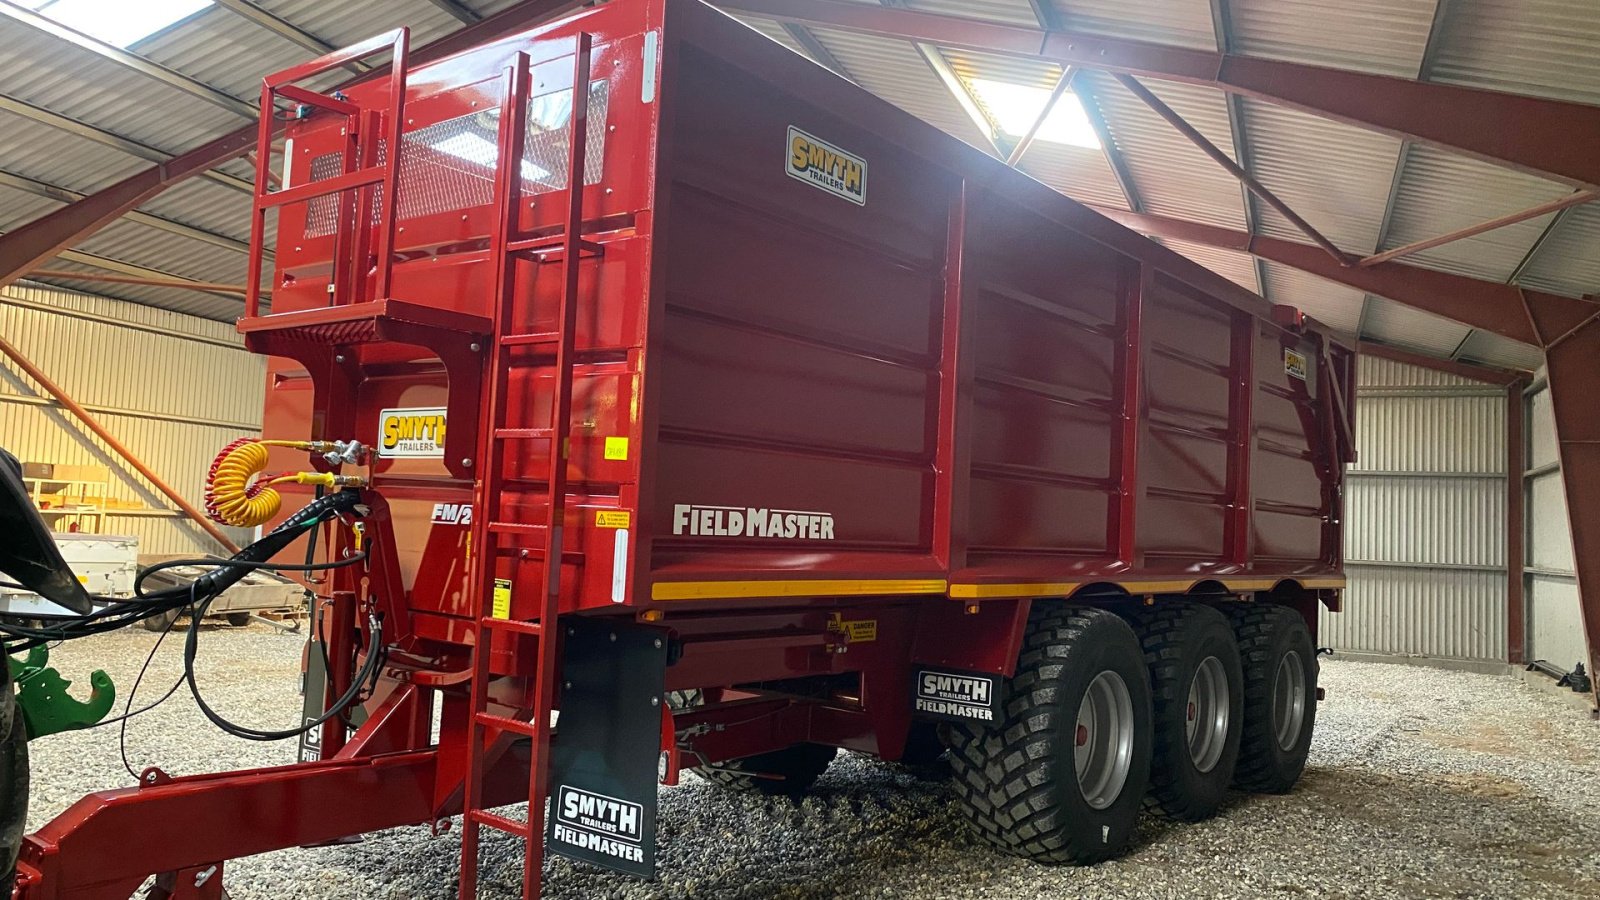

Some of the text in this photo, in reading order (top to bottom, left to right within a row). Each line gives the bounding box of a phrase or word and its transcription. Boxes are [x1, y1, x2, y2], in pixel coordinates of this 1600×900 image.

[792, 136, 861, 195] SMYTH
[809, 169, 844, 191] TRAILERS
[399, 442, 434, 451] TRAILERS
[431, 503, 473, 524] FM/2
[673, 504, 834, 539] FIELDMASTER
[924, 675, 987, 701] SMYTH
[939, 692, 971, 701] TRAILERS
[916, 699, 993, 720] FIELDMASTER
[564, 791, 637, 834] SMYTH
[580, 816, 617, 833] TRAILERS
[554, 823, 644, 863] FIELDMASTER
